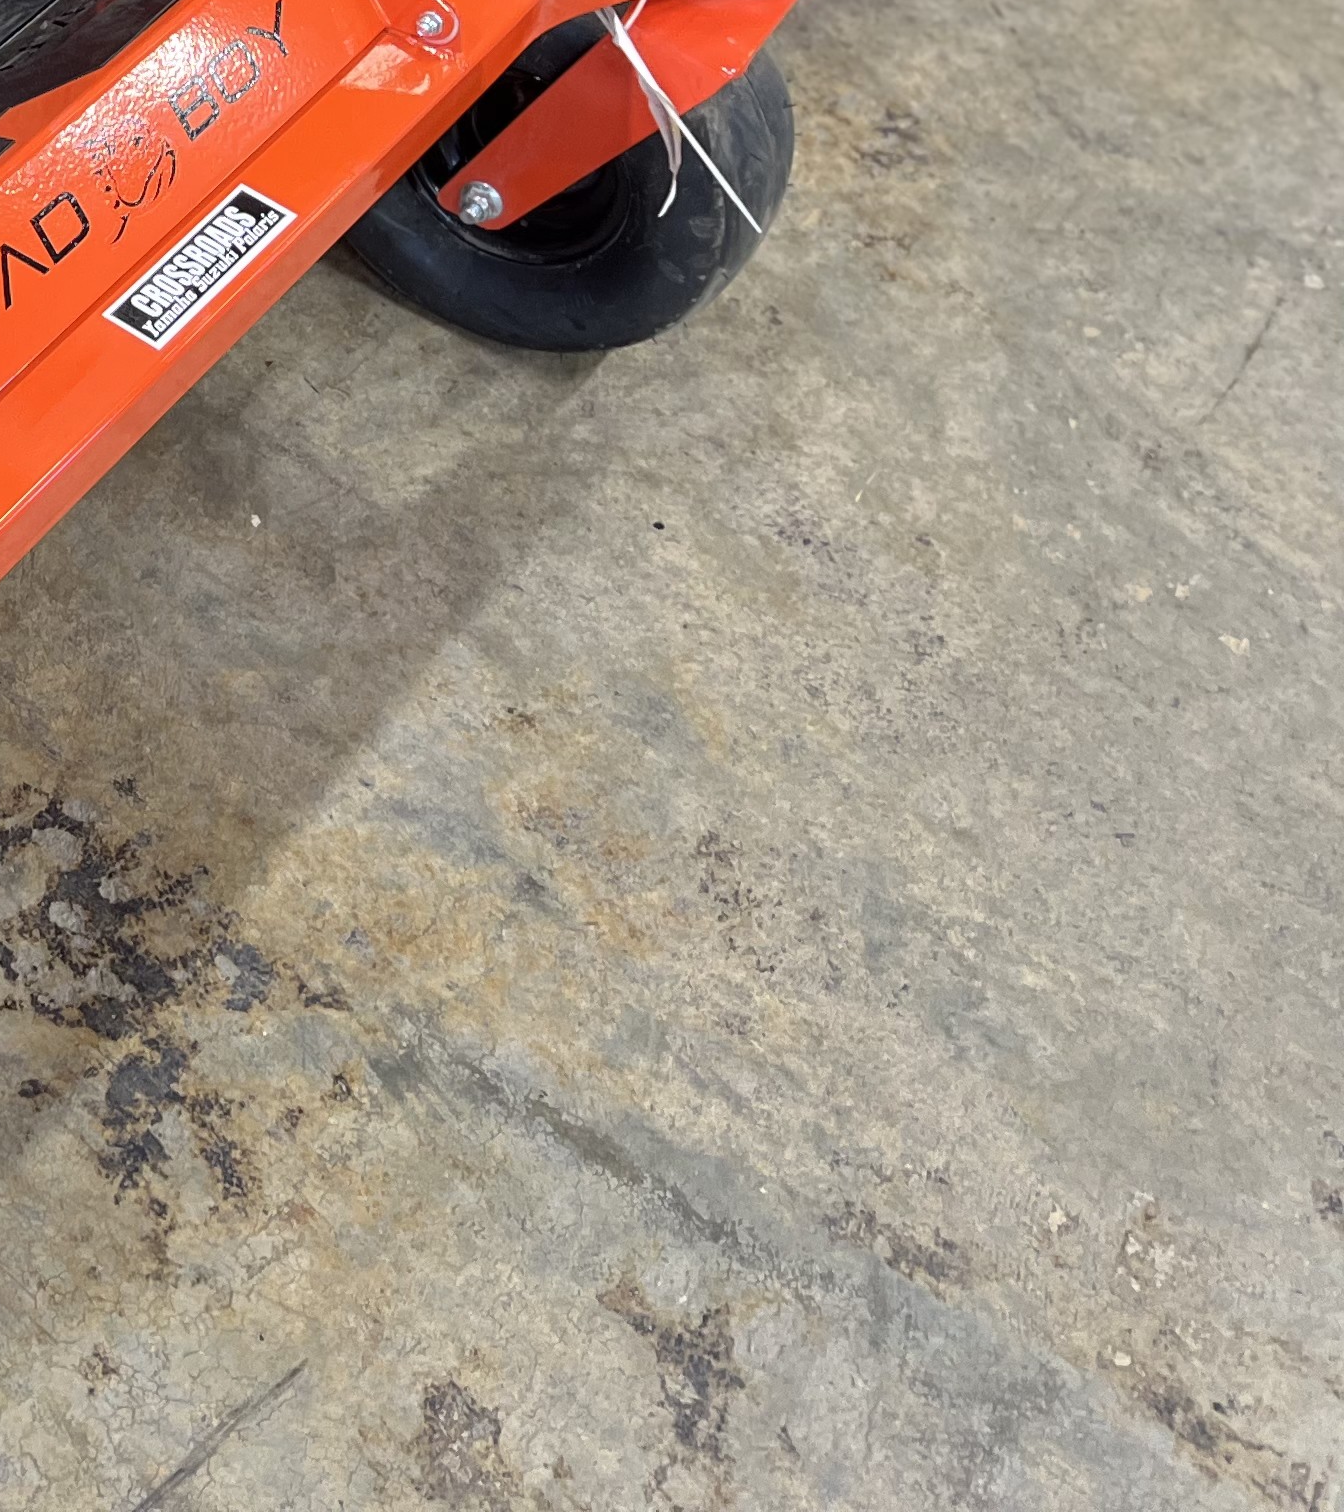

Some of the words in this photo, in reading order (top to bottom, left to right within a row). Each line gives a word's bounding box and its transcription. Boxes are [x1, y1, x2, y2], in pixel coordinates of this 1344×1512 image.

[130, 204, 258, 318] CROSSROADS
[140, 286, 200, 337] Yamaha
[186, 245, 242, 293] Suzuki
[227, 206, 283, 254] Polaris
